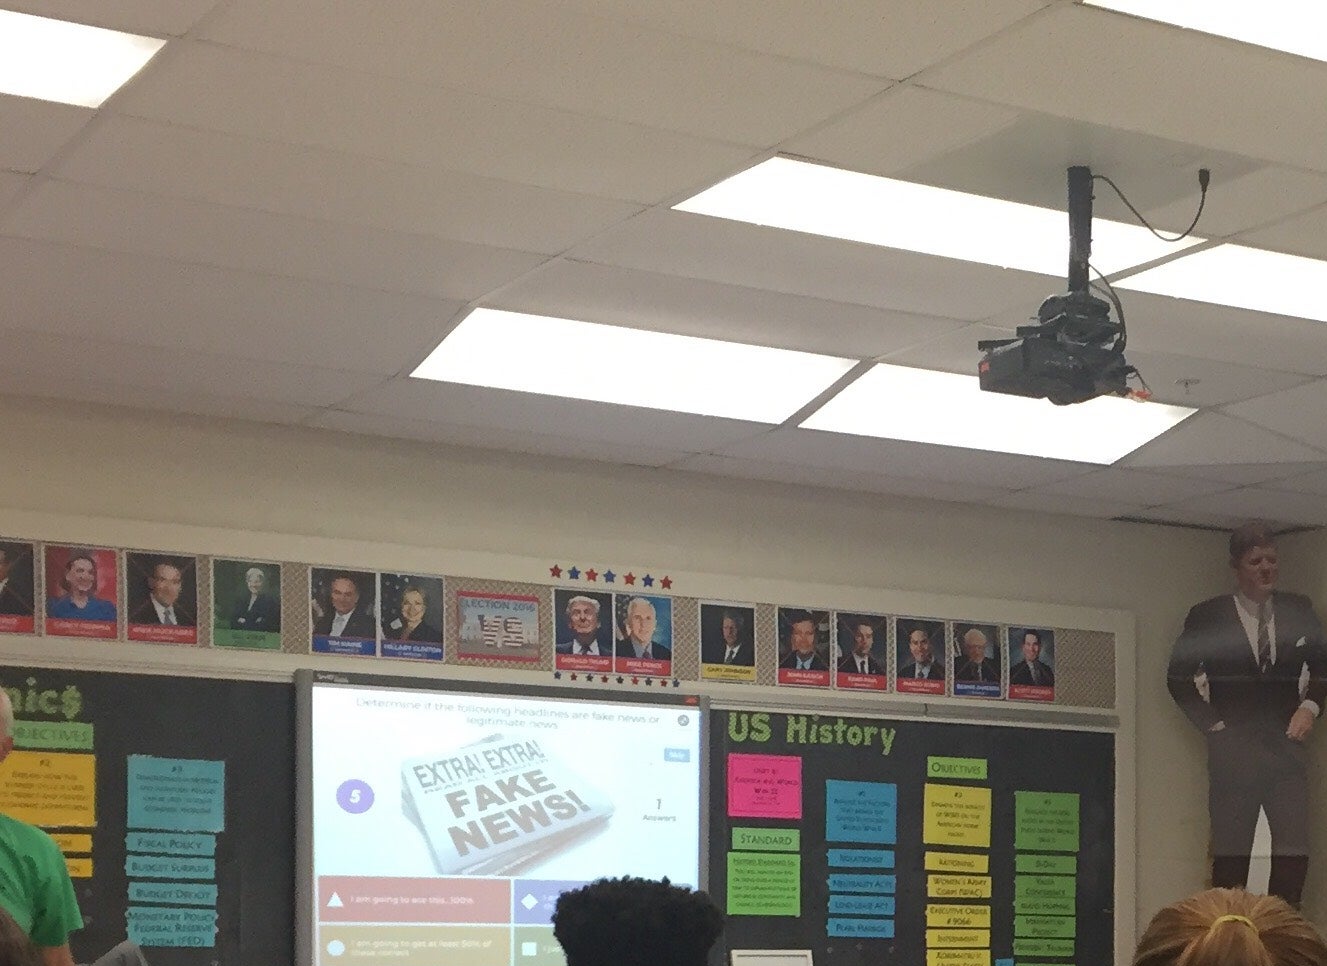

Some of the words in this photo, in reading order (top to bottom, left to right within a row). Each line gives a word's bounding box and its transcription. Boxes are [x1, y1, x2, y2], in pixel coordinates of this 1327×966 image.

[356, 698, 421, 710] Determine
[434, 702, 454, 712] the
[457, 703, 511, 717] following
[514, 706, 570, 720] headlines
[571, 712, 589, 721] are
[591, 711, 614, 722] fake
[617, 714, 645, 724] news
[465, 715, 526, 728] legitimate
[728, 712, 772, 742] US
[786, 715, 897, 756] History
[413, 754, 486, 788] EXTRA!
[482, 739, 546, 770] EXTRA!
[349, 788, 362, 804] 5
[444, 769, 557, 819] FAKE
[447, 789, 592, 857] NEWS!
[170, 839, 202, 850] POLICY
[740, 833, 792, 846] STANDARD
